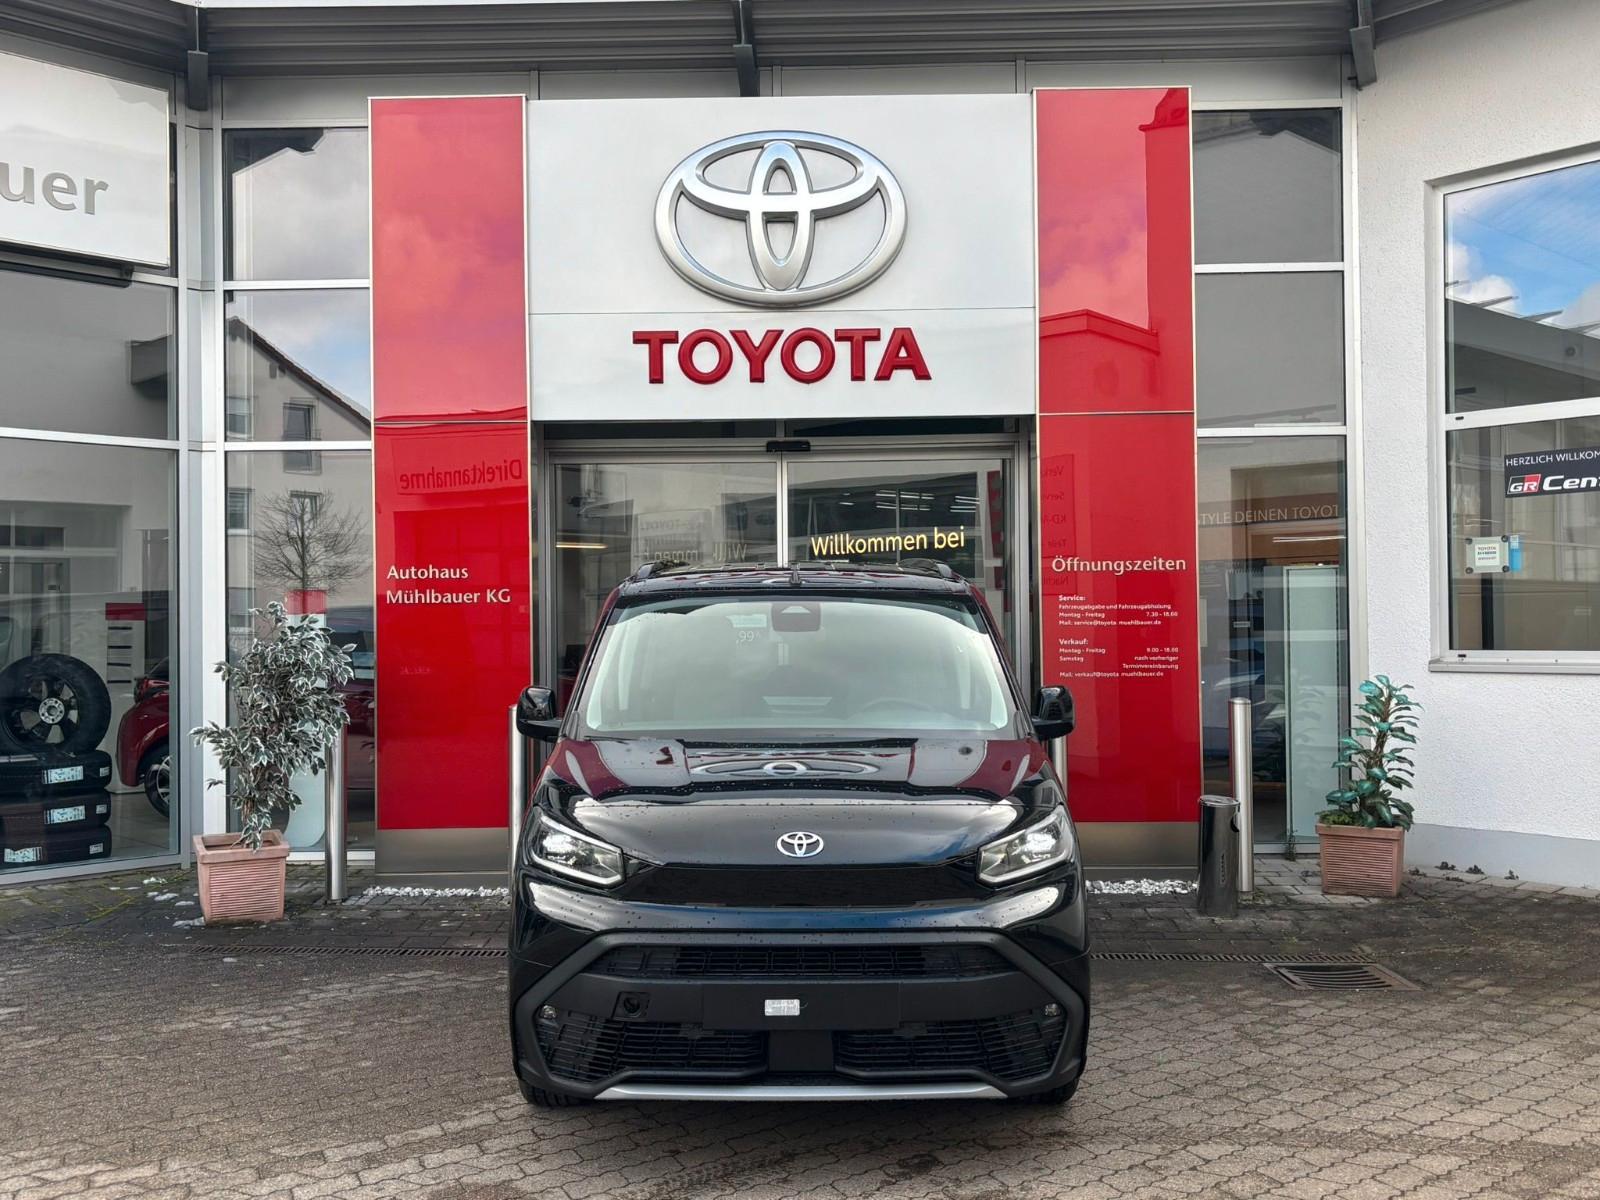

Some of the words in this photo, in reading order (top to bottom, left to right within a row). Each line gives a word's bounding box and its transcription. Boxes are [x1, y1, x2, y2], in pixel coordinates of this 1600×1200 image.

[632, 327, 932, 385] TOYOTA
[1506, 454, 1553, 467] HERZLICH
[1542, 475, 1600, 491] Cen
[1198, 511, 1232, 525] TYLE
[1235, 507, 1288, 523] DEINEN
[811, 532, 927, 556] Willkommen
[934, 525, 965, 549] bei
[386, 564, 469, 580] Autohaus
[1052, 555, 1187, 576] Öffnungszeiten
[386, 589, 480, 604] Mühlbauer
[486, 588, 511, 603] KG
[1058, 594, 1086, 602] Service:
[1059, 647, 1081, 655] Montag
[1086, 647, 1106, 655] Freitag
